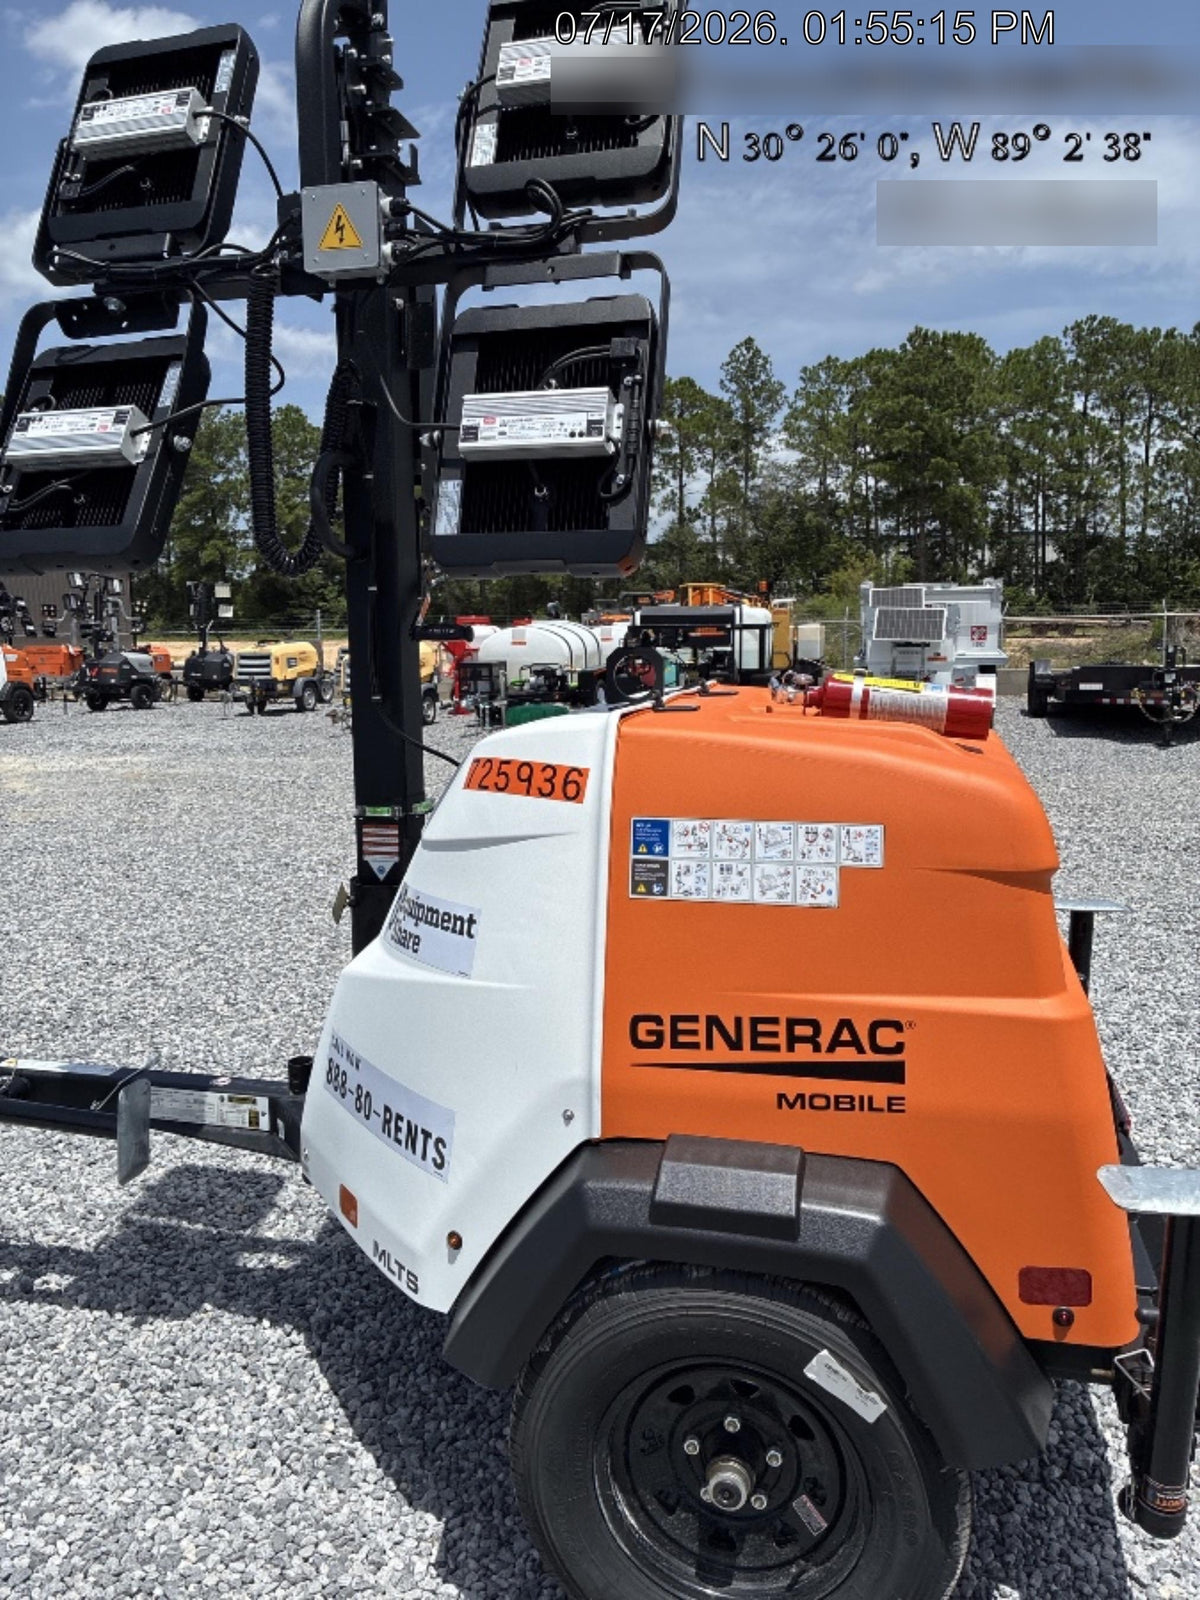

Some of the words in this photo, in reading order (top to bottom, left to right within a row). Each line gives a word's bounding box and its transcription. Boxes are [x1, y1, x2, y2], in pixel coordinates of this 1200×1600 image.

[466, 757, 584, 802] 725936
[326, 1057, 448, 1171] 888-80-RENTS
[776, 1093, 906, 1114] MOBILE
[373, 1239, 420, 1295] MLTS
